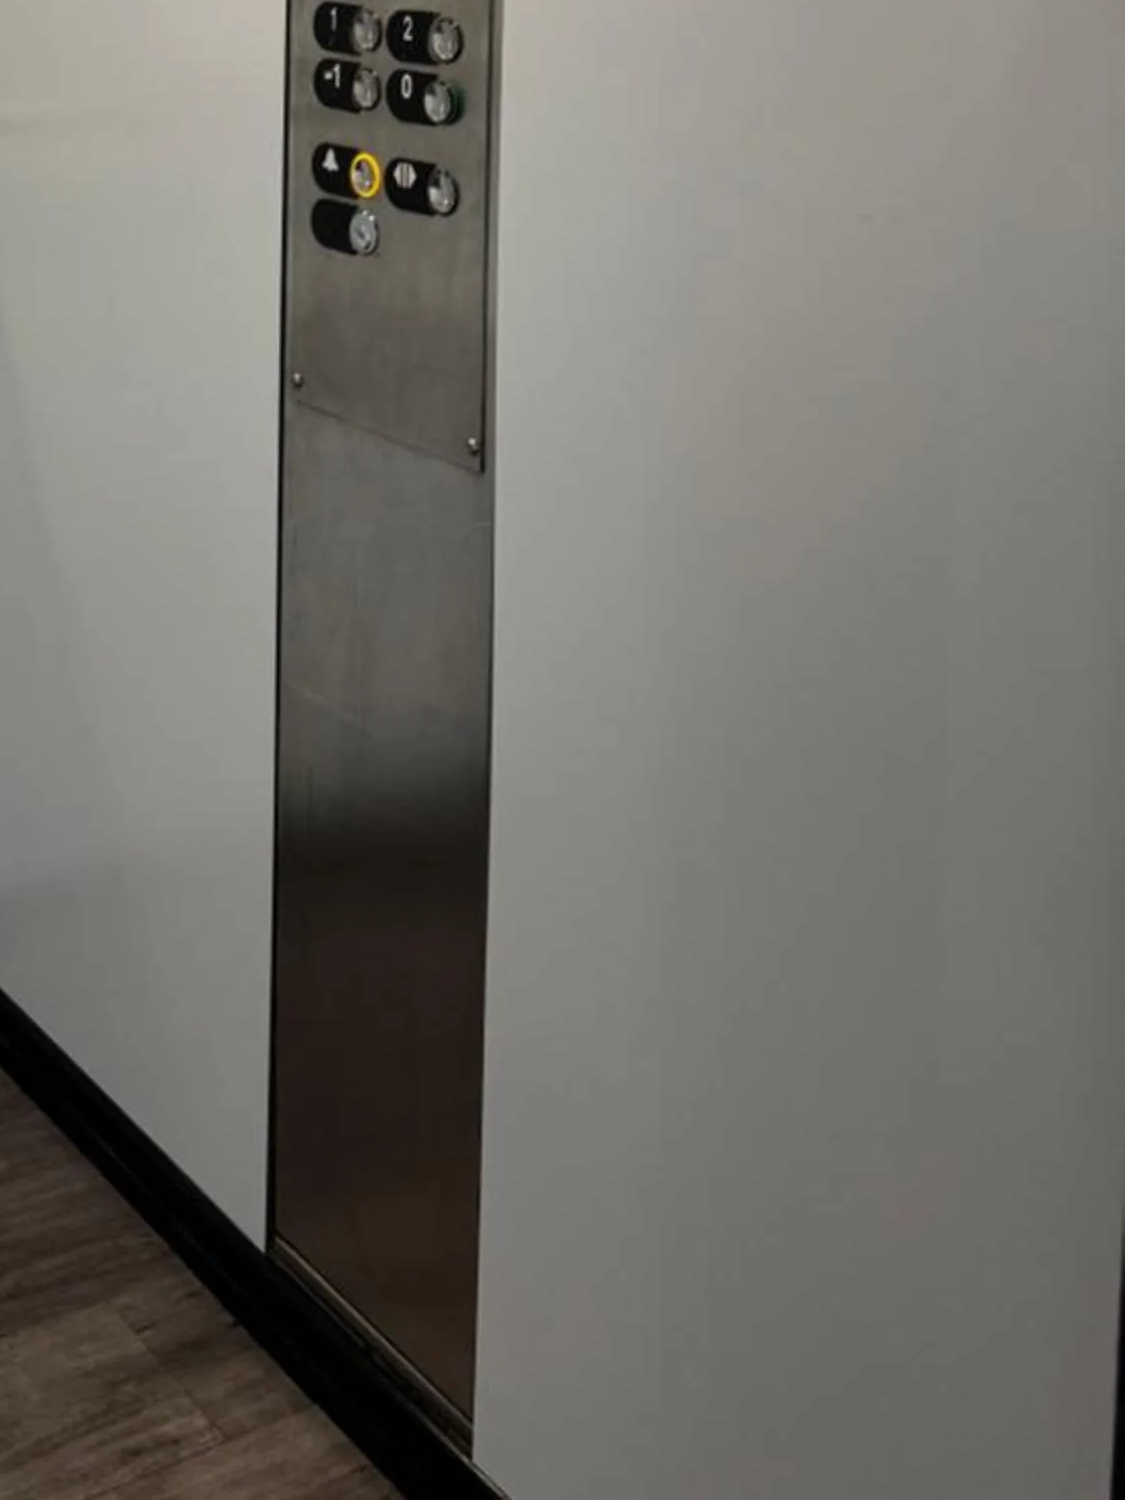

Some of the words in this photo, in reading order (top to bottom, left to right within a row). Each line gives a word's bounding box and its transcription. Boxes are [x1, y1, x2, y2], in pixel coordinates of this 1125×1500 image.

[330, 7, 338, 32] 1
[402, 15, 414, 42] 2
[324, 63, 341, 88] -1
[401, 73, 413, 99] 0
